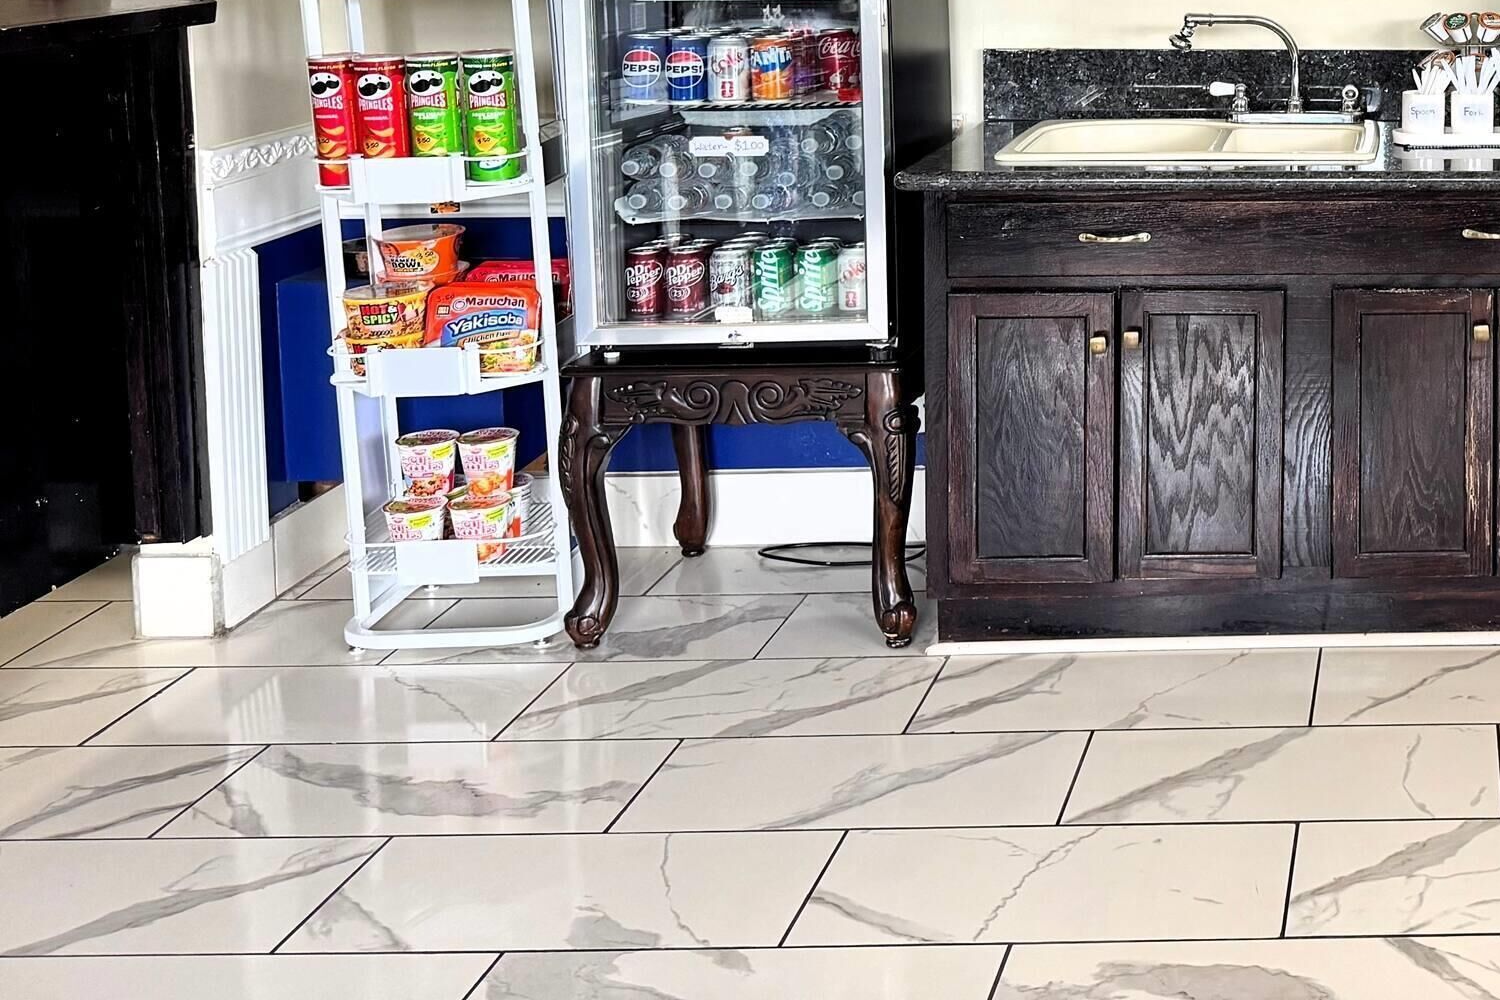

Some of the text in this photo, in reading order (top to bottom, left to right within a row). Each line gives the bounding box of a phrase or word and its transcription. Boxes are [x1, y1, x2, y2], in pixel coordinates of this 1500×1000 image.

[623, 64, 660, 73] PEPSI
[666, 65, 702, 74] PEPSI
[311, 95, 343, 110] PRINGLES
[359, 96, 394, 112] PRINGLES
[411, 92, 446, 108] PRINGLES
[469, 92, 506, 108] PRINGLES
[734, 138, 764, 152] $1.00
[625, 265, 661, 287] Pepper
[634, 264, 652, 275] Dr
[666, 265, 702, 286] Pepper
[676, 264, 693, 275] Dr
[499, 273, 559, 281] Marucn
[710, 264, 745, 292] Barq's
[755, 249, 784, 312] Sprite
[798, 249, 827, 312] Sprite
[631, 290, 640, 298] 23
[672, 290, 682, 298] 23
[466, 297, 525, 308] Maruchan
[360, 304, 388, 316] HOT
[362, 313, 399, 325] SPICY
[447, 311, 525, 337] Yakisoba
